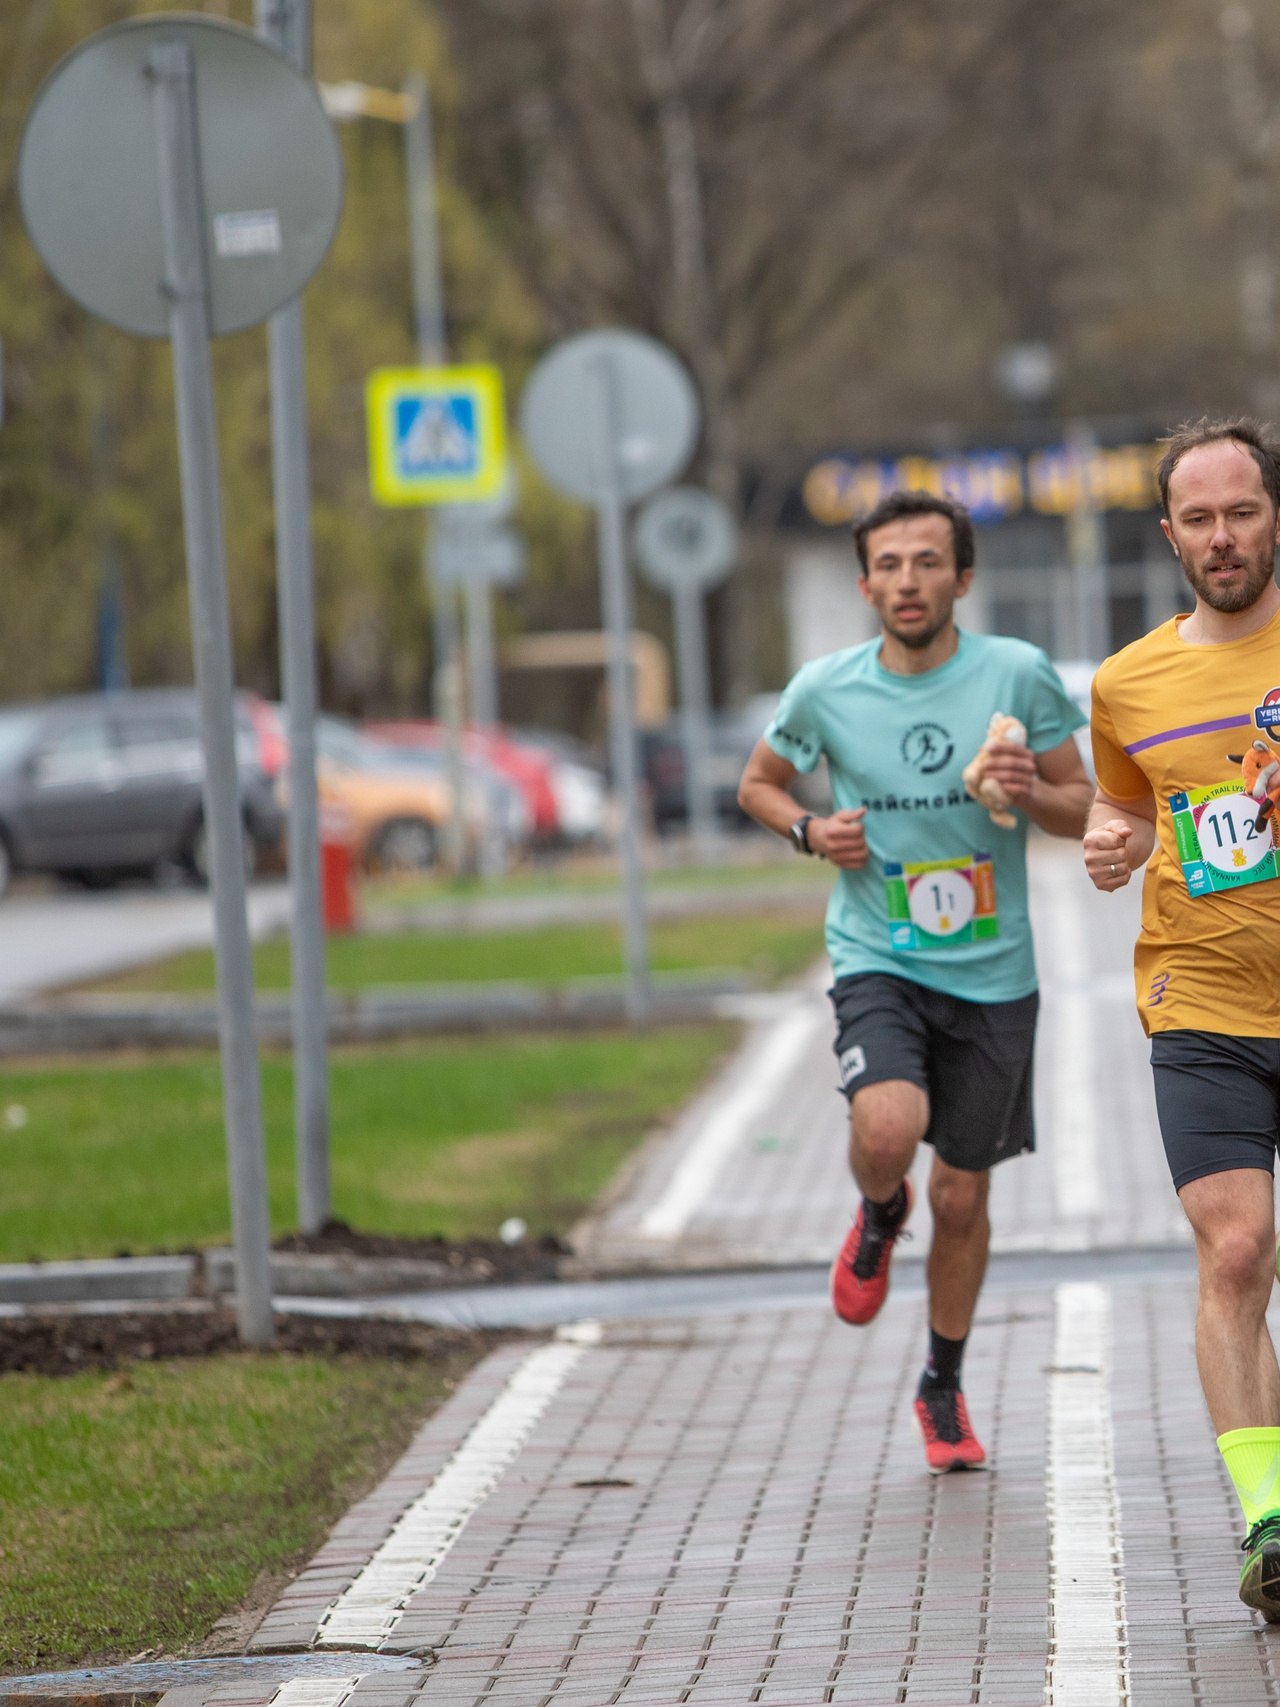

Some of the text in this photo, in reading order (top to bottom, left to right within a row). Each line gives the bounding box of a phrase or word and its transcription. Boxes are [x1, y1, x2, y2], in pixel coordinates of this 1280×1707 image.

[1194, 795, 1211, 819] DREAM
[1211, 785, 1230, 797] TRAIL
[1191, 831, 1201, 852] TRAIL
[1208, 811, 1237, 847] 11
[1243, 818, 1258, 841] 2
[1264, 813, 1280, 865] ИМКИНСКИЙ
[1211, 870, 1241, 881] KANNAS
[931, 885, 956, 912] 1 1
